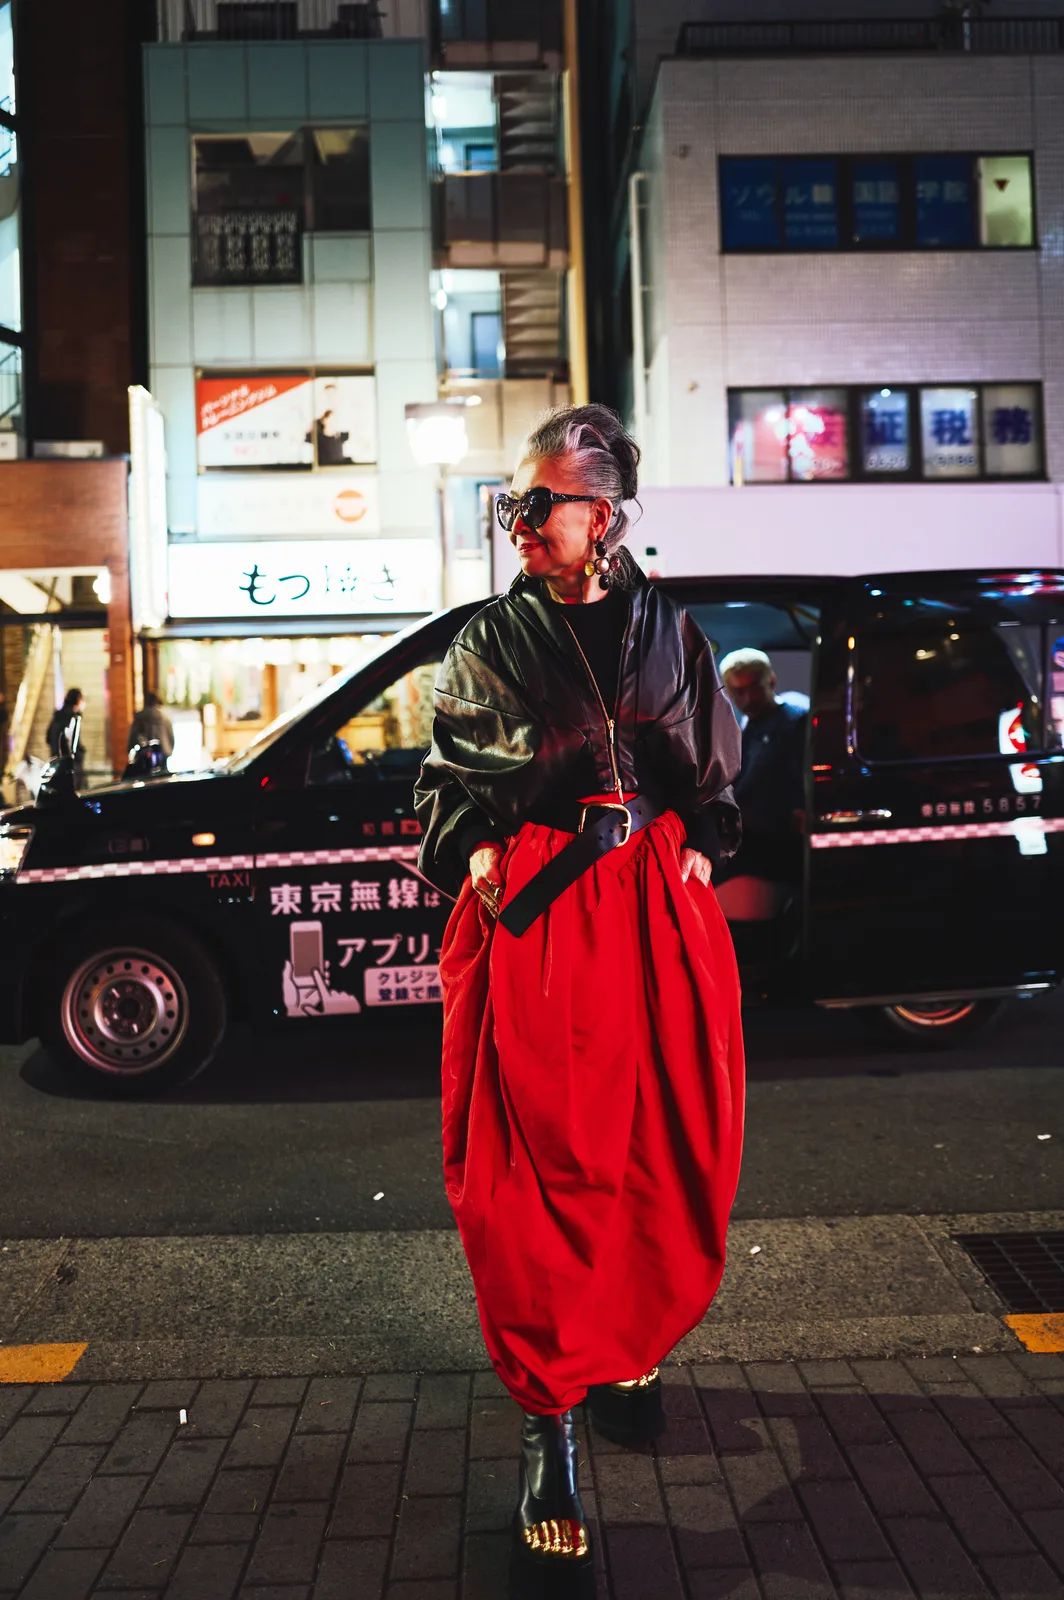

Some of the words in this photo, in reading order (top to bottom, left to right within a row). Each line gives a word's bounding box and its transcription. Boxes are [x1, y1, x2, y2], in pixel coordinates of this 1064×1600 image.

[982, 794, 1043, 814] 5857
[207, 872, 250, 889] TAXI
[336, 933, 441, 968] アプリ
